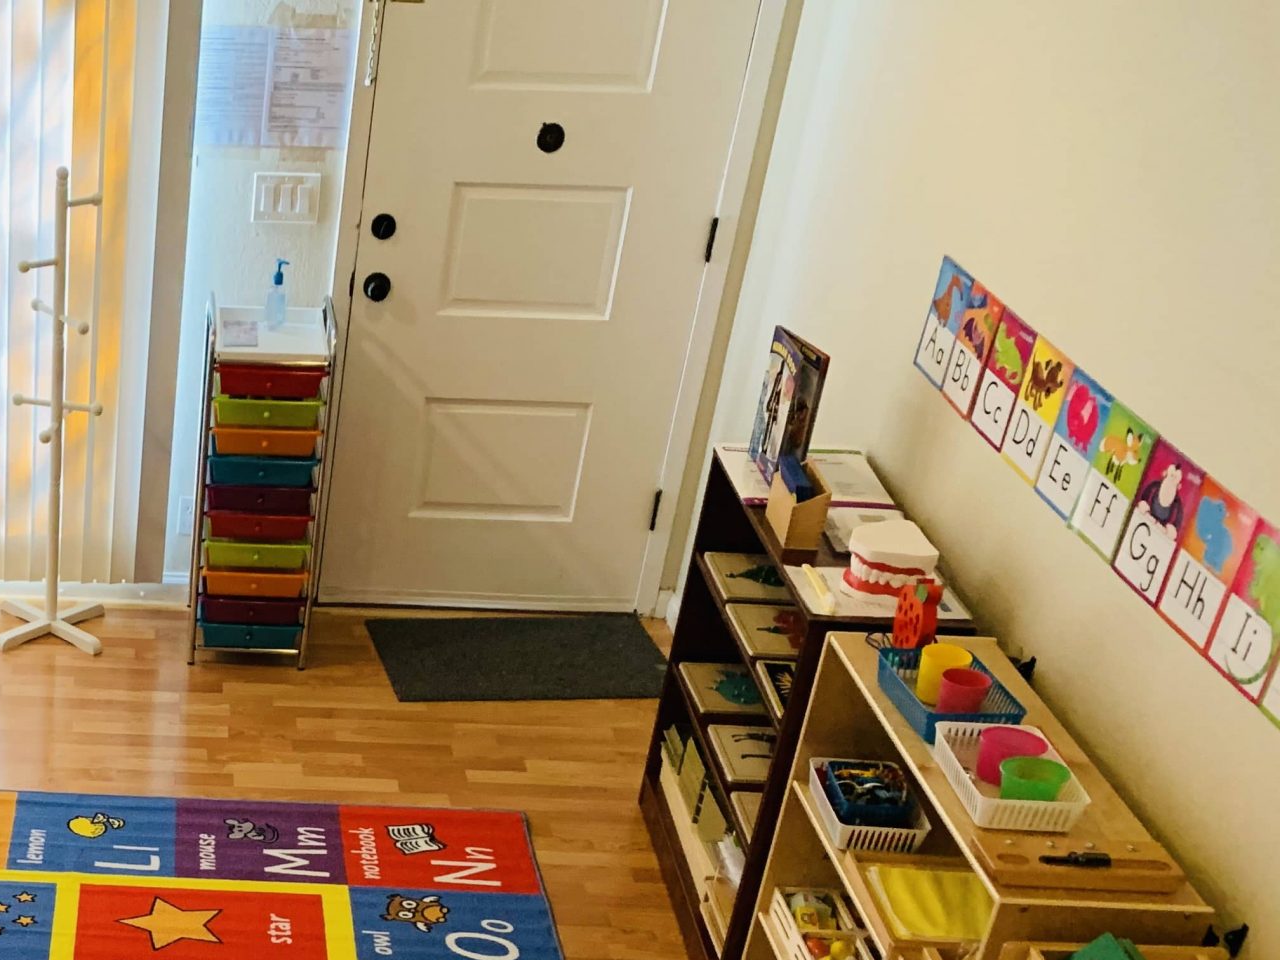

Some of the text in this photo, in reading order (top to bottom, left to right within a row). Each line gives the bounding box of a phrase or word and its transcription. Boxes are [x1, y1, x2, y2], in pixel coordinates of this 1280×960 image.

[925, 327, 944, 366] Aa
[951, 348, 970, 392] Bb
[983, 381, 1003, 425] Cc
[1012, 409, 1041, 459] Dd
[1048, 444, 1072, 492] Ee
[1089, 481, 1118, 529] Ff
[1130, 523, 1160, 592] Gg
[1175, 560, 1206, 621] Hh
[1231, 612, 1258, 662] Ii
[17, 829, 46, 864] lemon
[94, 845, 160, 870] Ll
[199, 834, 216, 870] mouse
[263, 827, 330, 877] Mm
[349, 828, 380, 879] notebook
[434, 847, 502, 887] Nn
[268, 914, 292, 944] star
[362, 930, 392, 955] owl
